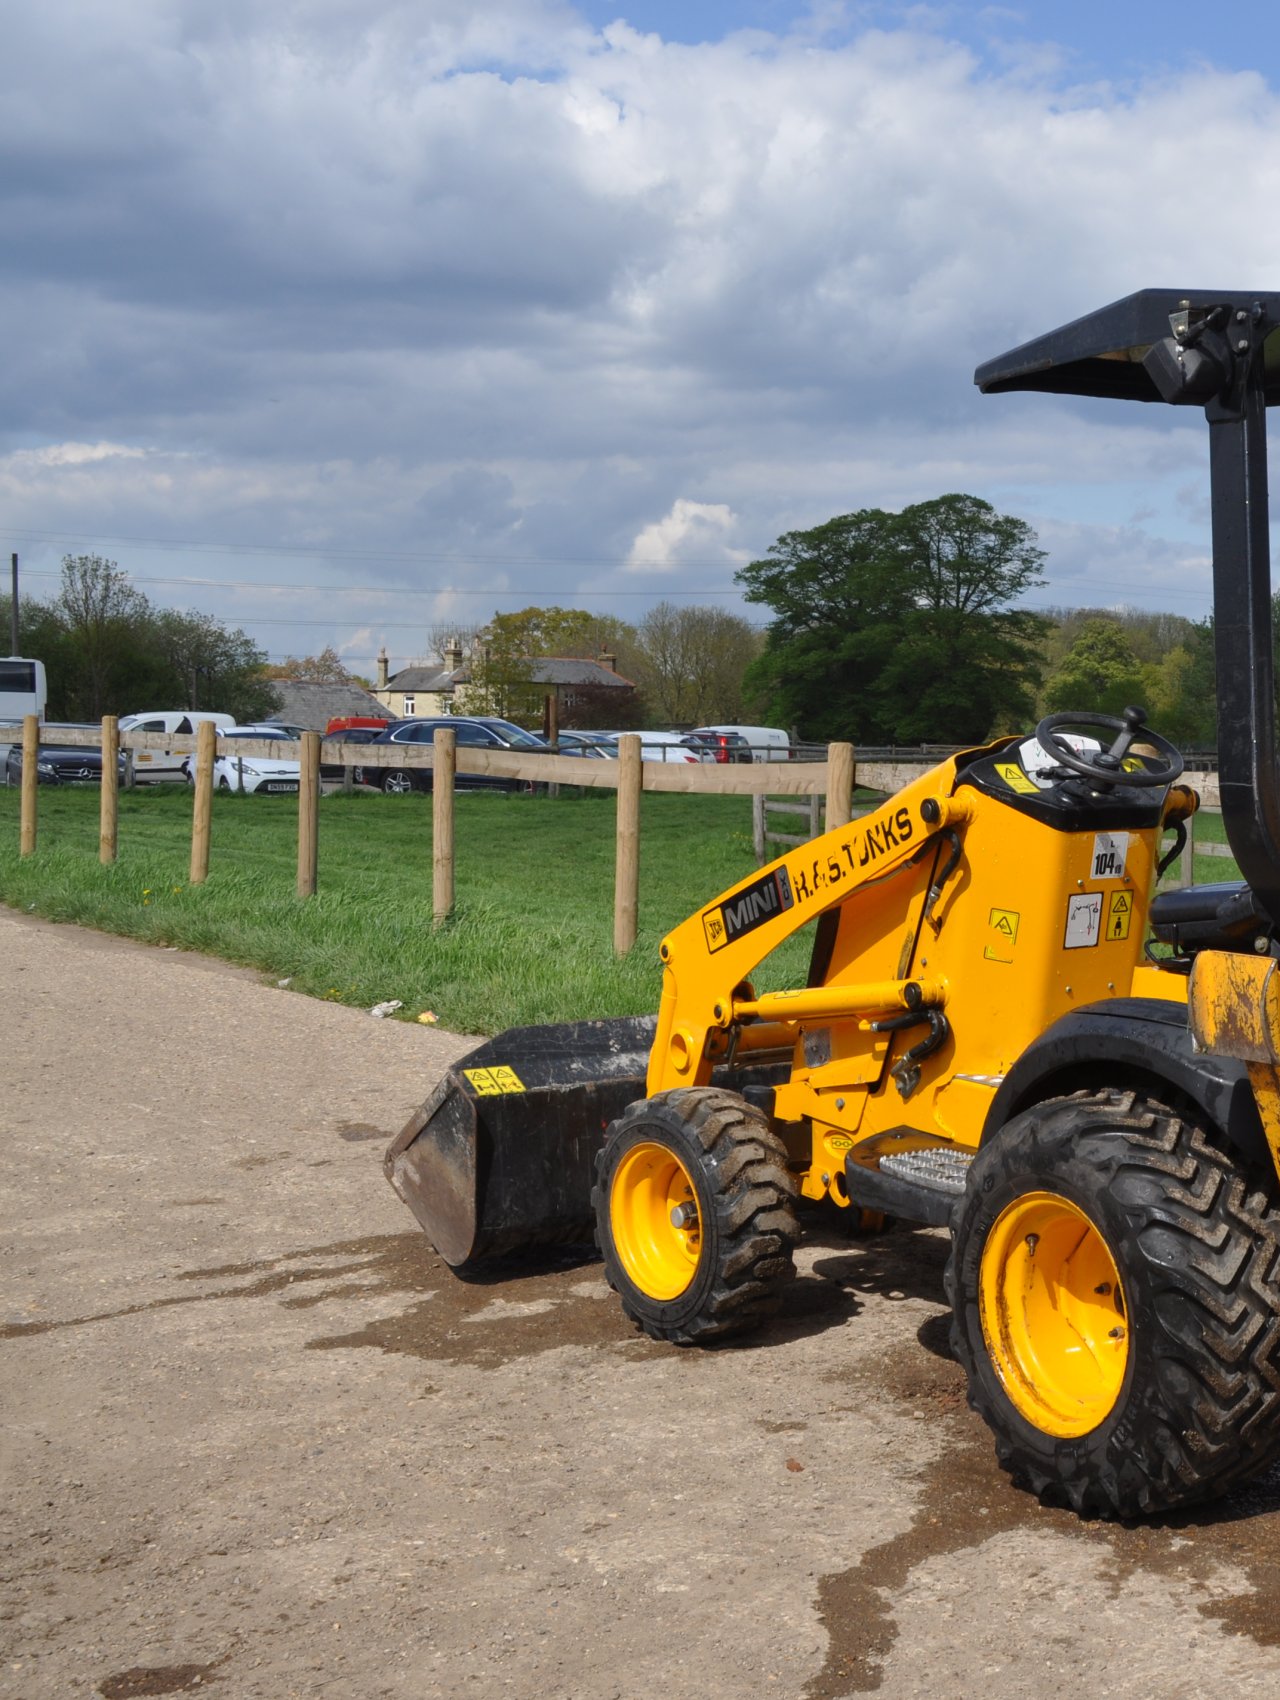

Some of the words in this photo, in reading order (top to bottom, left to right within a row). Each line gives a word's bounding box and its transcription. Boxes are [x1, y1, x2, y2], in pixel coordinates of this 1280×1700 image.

[1095, 853, 1115, 875] 104
[724, 882, 778, 935] MINI
[709, 920, 723, 938] JCB
